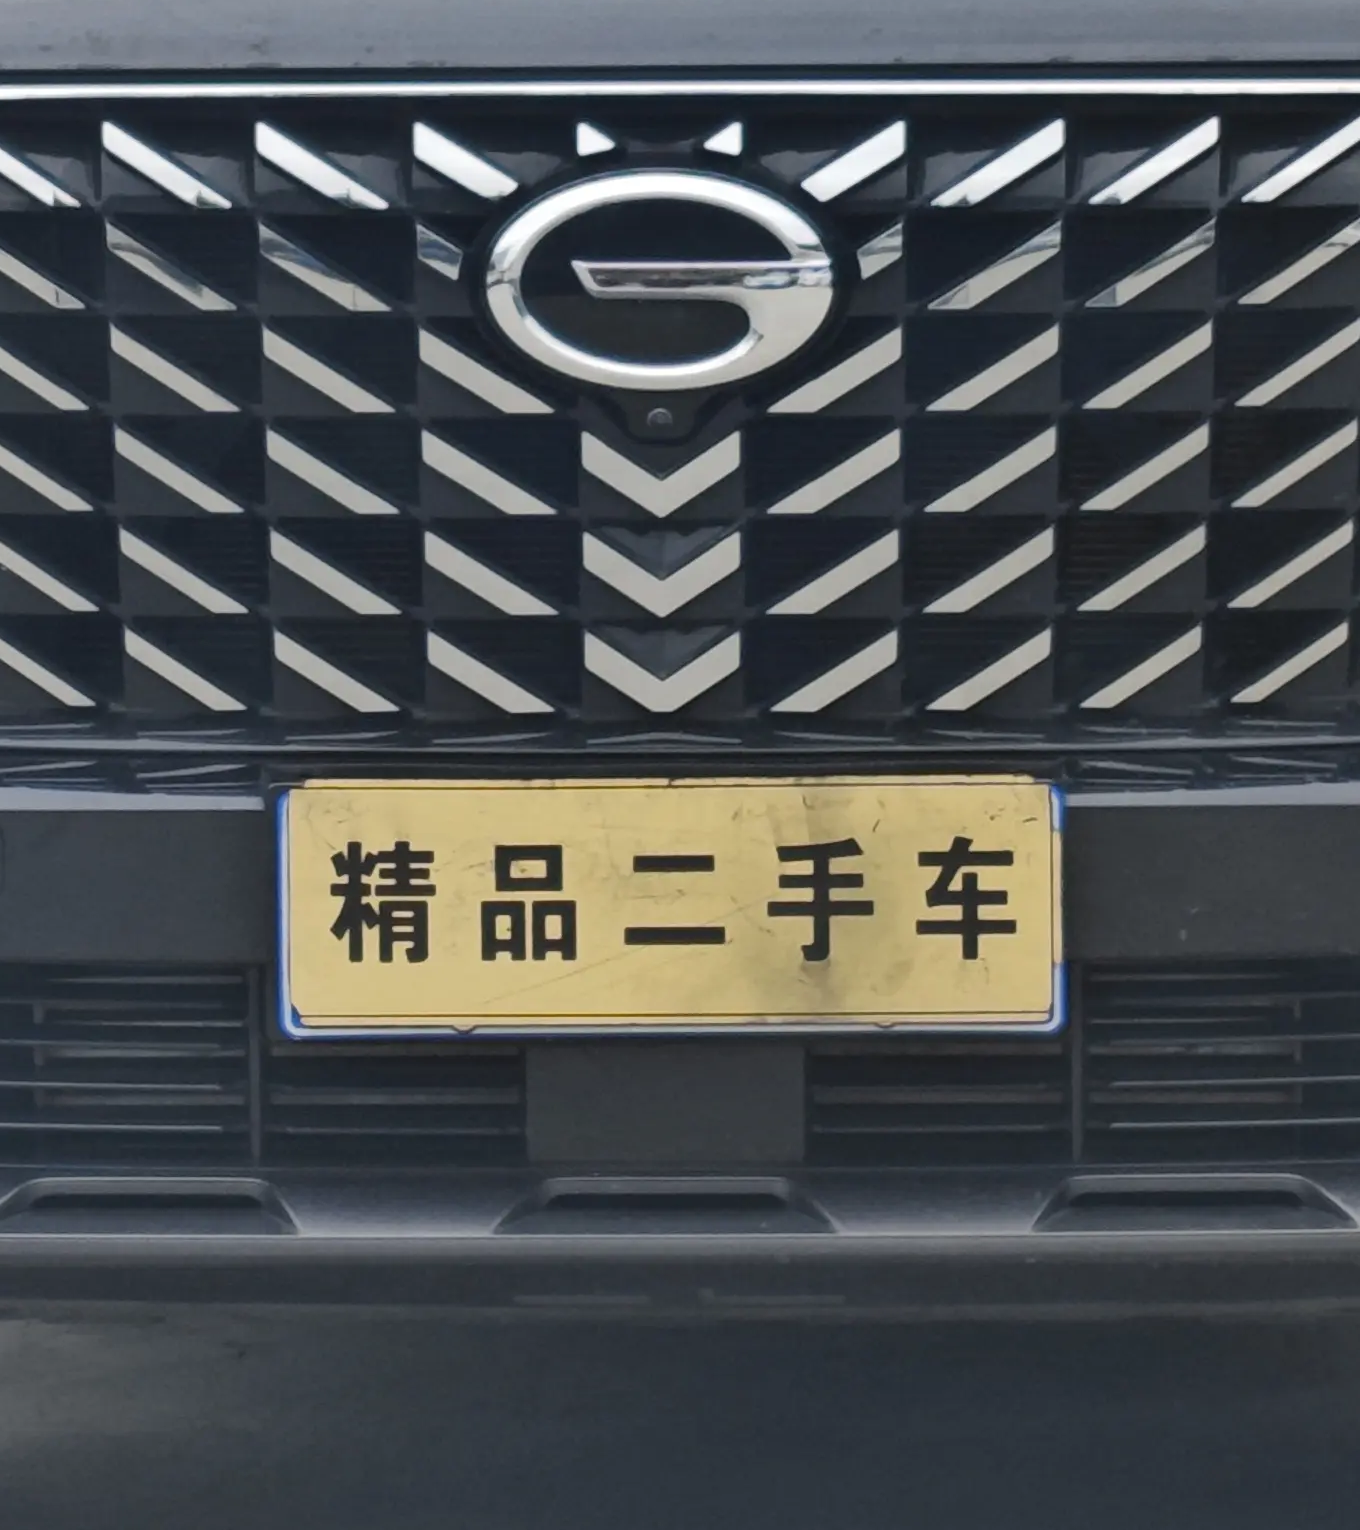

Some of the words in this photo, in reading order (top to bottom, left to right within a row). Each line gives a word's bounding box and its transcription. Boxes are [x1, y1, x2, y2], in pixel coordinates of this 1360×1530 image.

[329, 837, 1017, 963] 精品二手车
